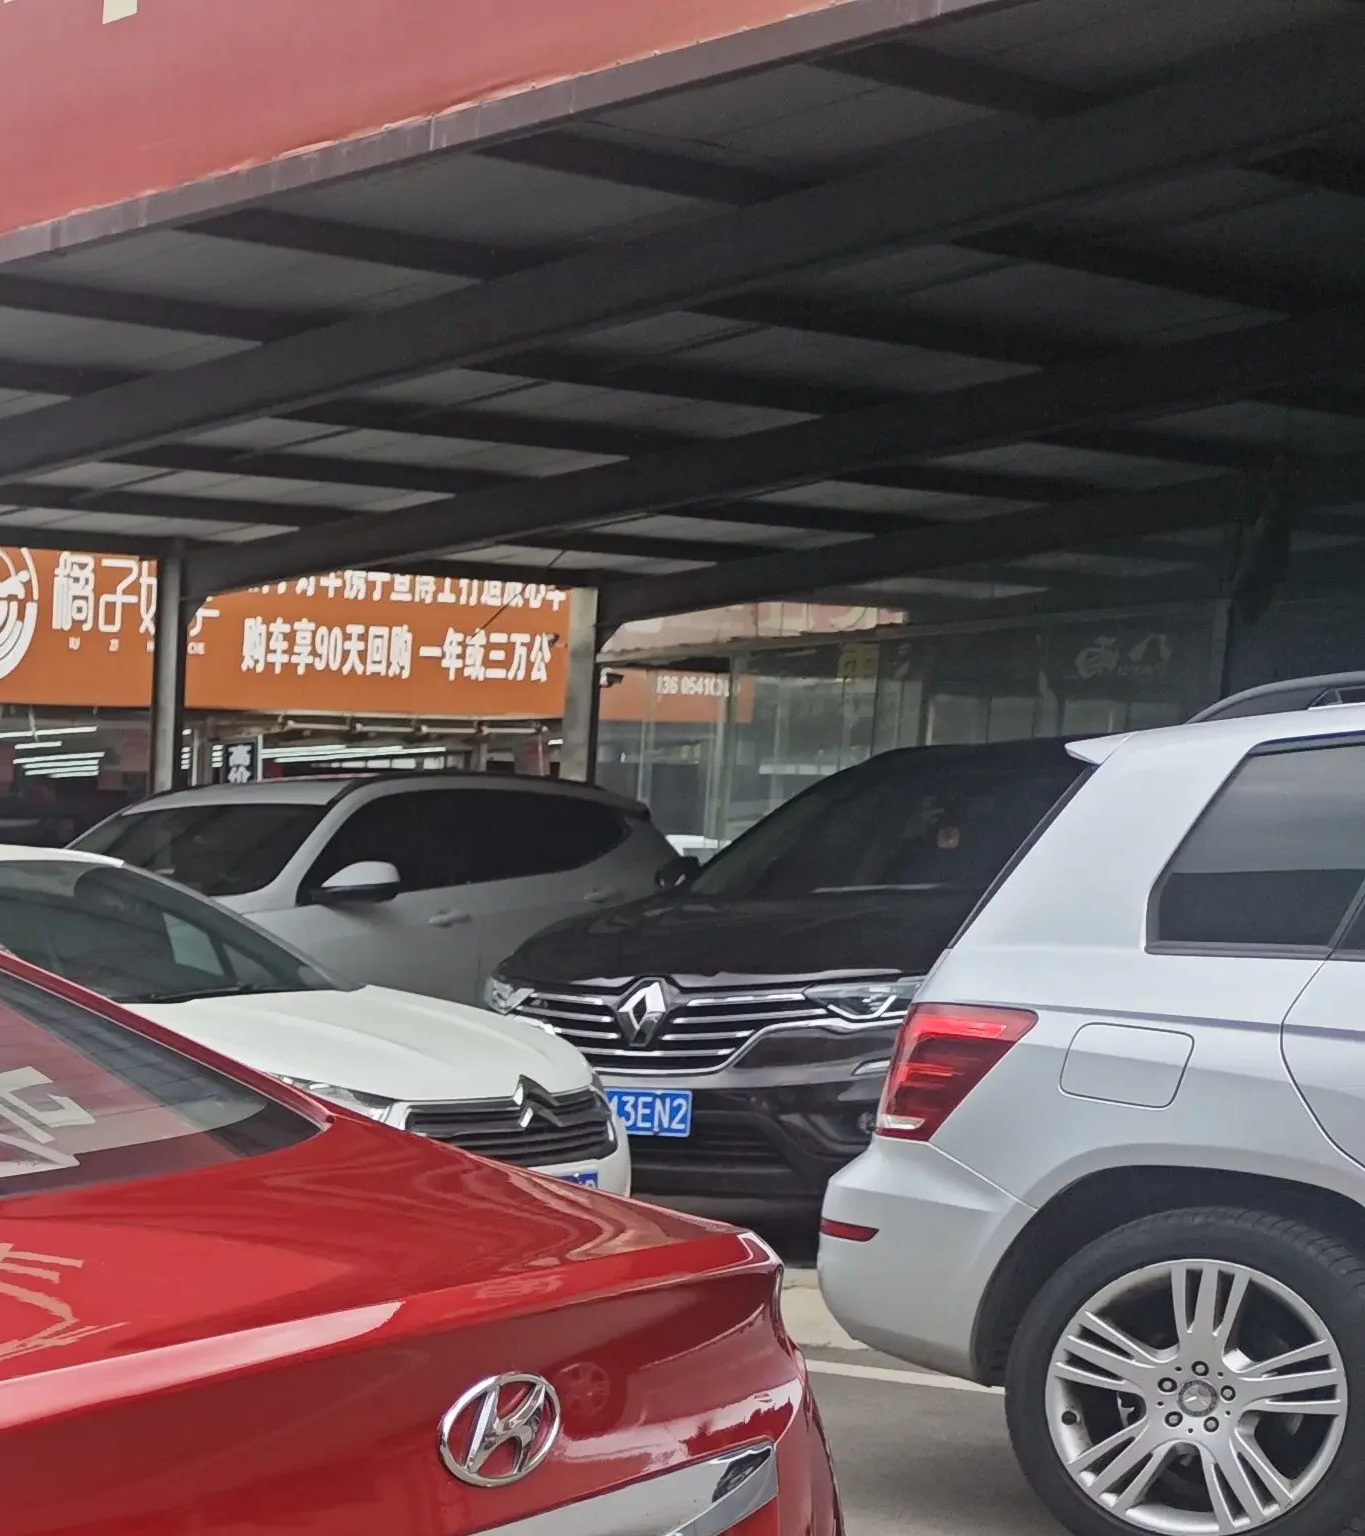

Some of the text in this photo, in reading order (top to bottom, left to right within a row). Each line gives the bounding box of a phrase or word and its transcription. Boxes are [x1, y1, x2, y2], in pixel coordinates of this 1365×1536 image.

[241, 616, 414, 680] 购车享90天回购
